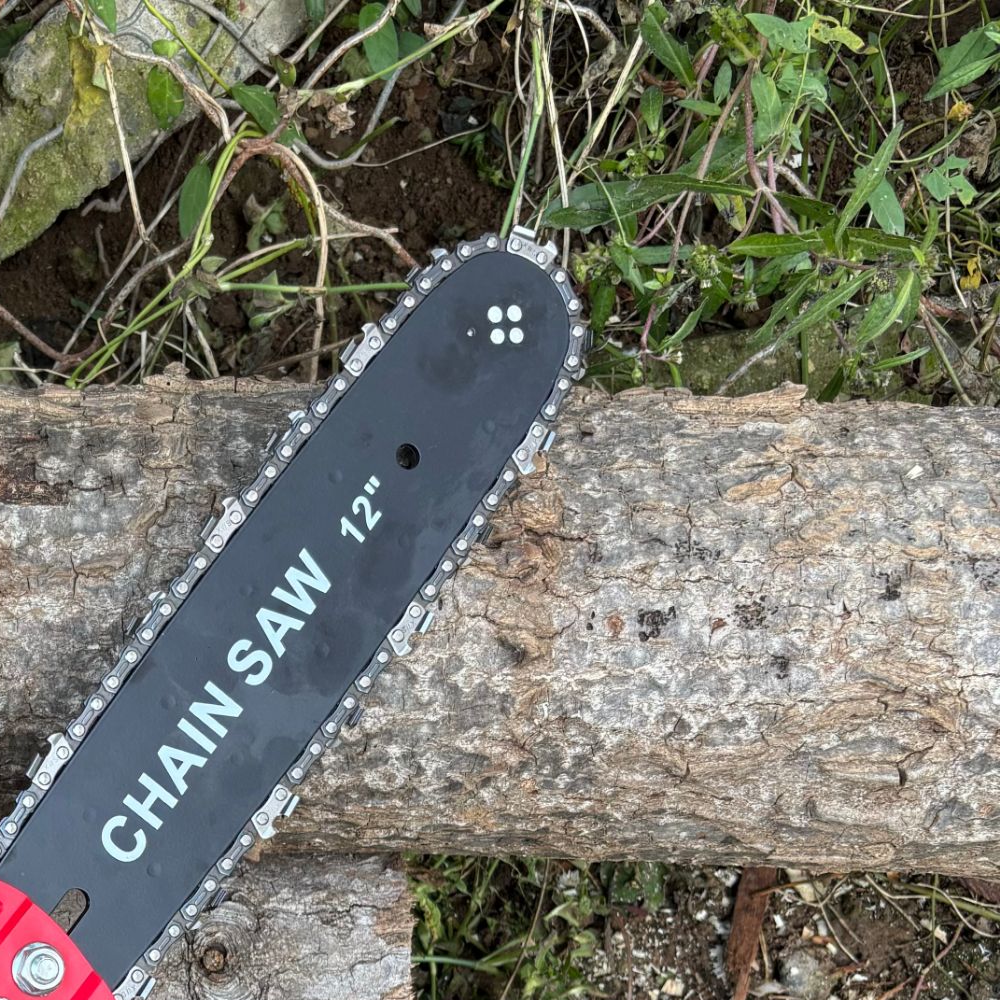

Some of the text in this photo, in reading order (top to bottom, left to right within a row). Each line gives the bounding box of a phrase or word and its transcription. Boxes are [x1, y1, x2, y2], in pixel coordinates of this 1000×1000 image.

[101, 475, 382, 863] CHAIN SAW 12"
